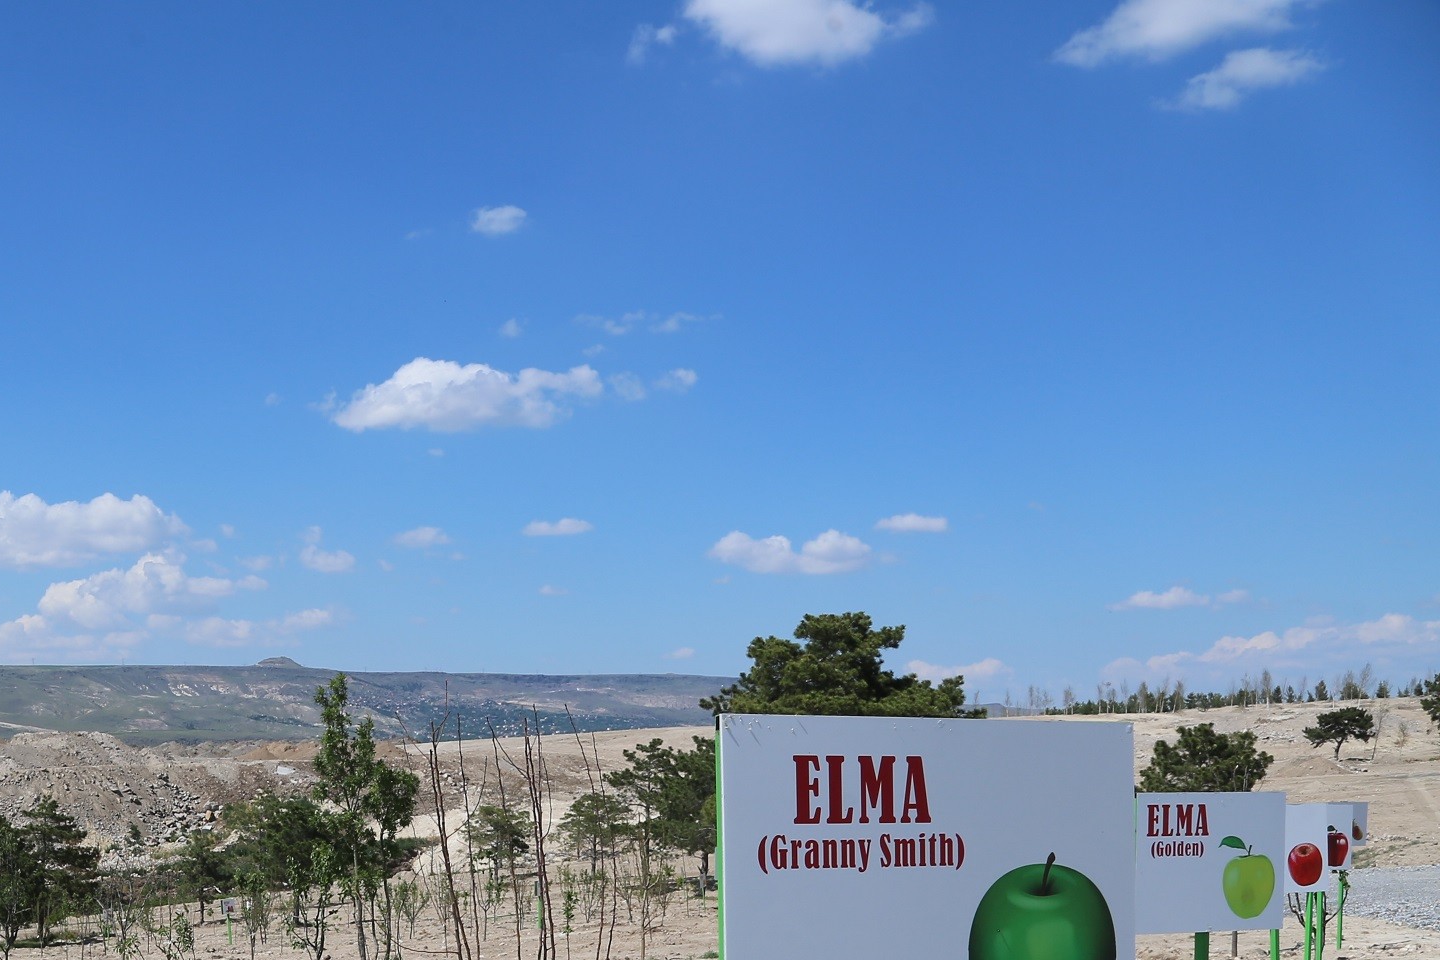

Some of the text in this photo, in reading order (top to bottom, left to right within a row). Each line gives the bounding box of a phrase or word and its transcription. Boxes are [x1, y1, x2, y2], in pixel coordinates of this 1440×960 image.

[792, 755, 932, 825] ELMA
[1146, 804, 1210, 837] ELMA
[757, 832, 965, 875] (Granny Smith)
[1150, 841, 1205, 859] (Golden)
